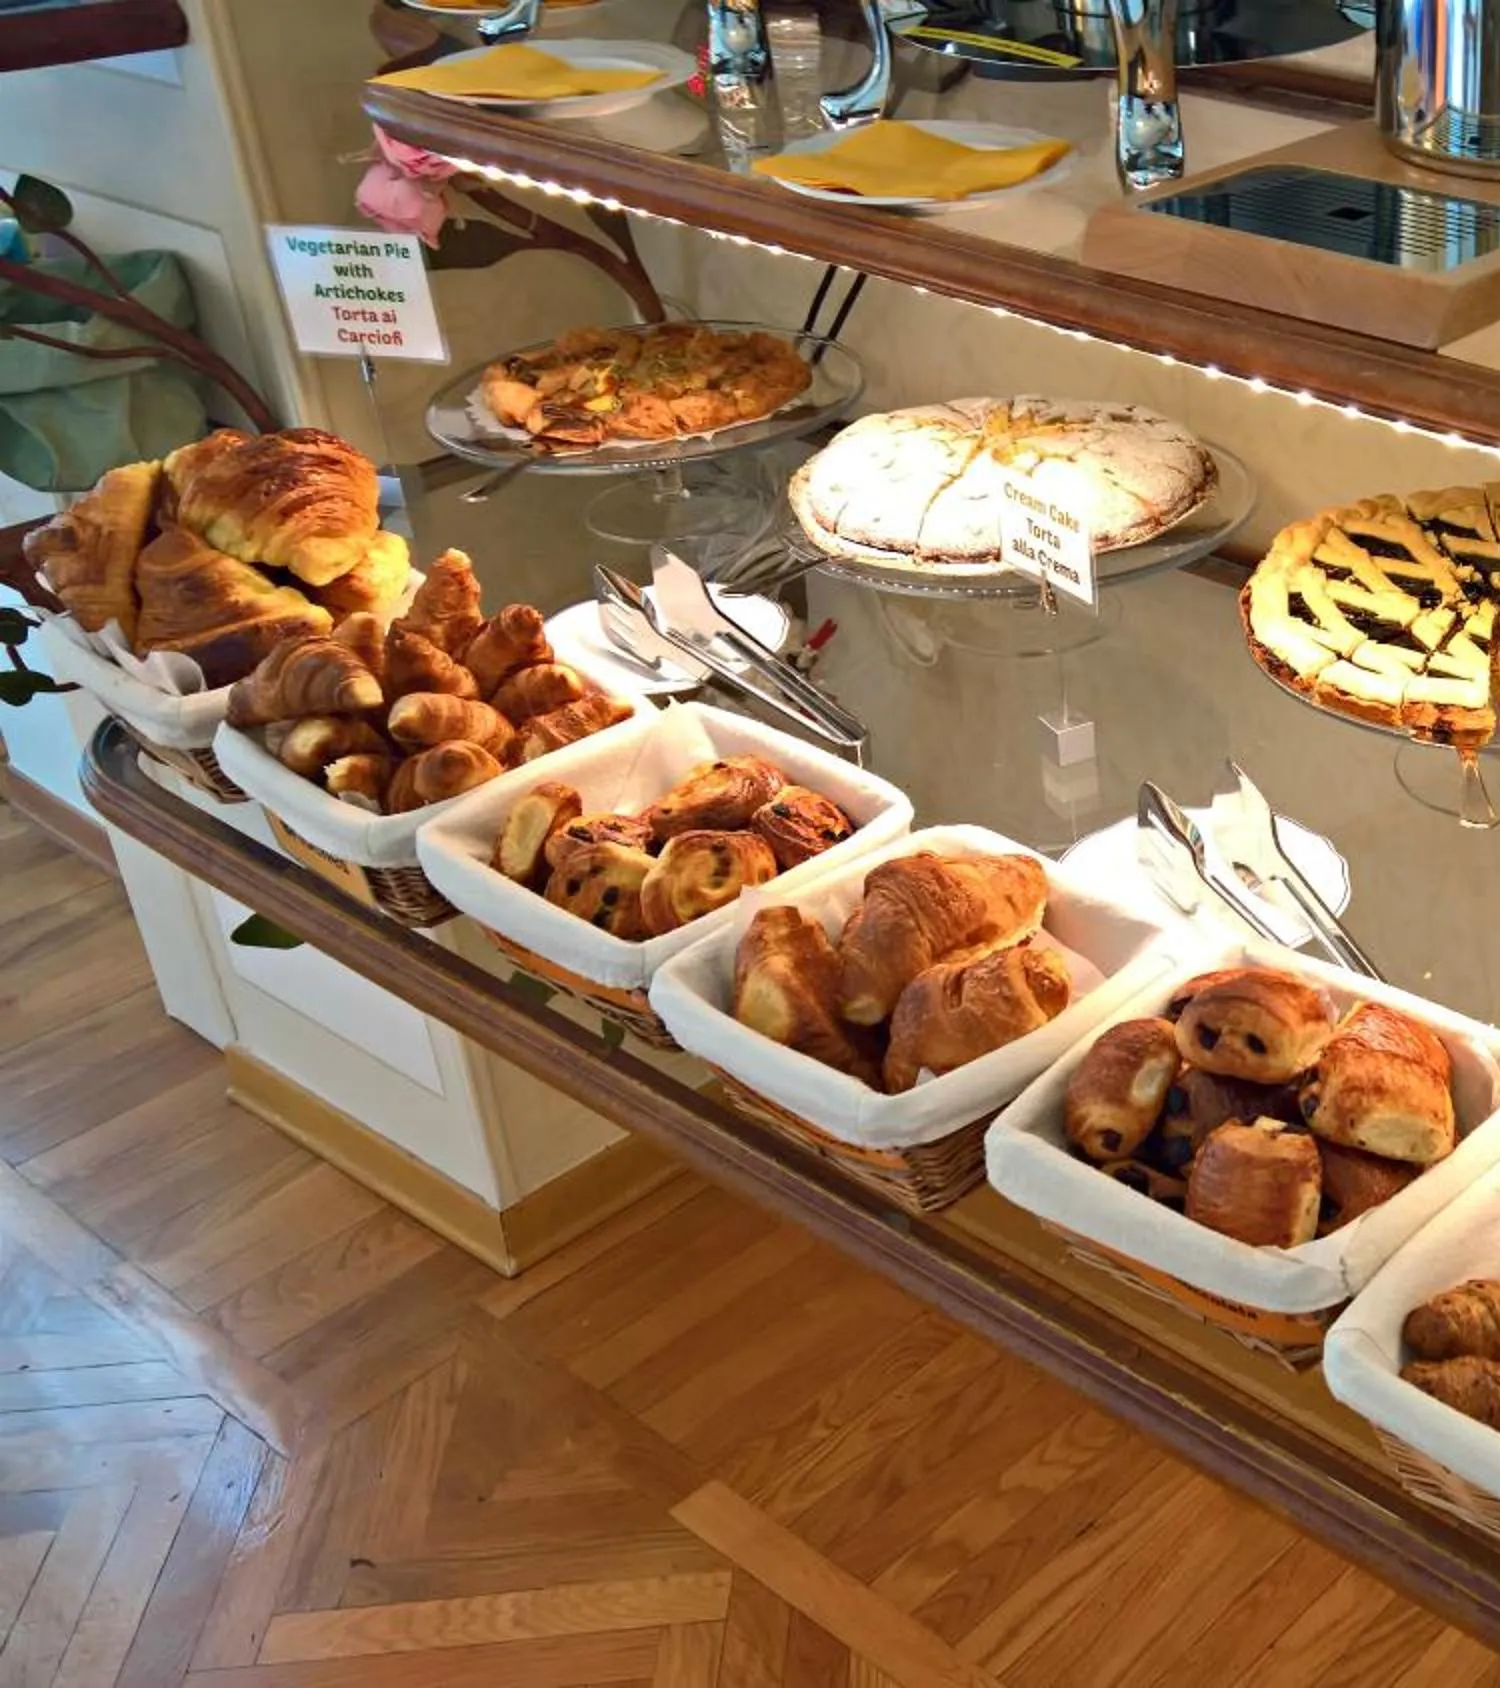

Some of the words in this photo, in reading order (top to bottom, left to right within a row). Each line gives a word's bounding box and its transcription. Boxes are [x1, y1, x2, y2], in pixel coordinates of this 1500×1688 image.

[285, 236, 381, 257] Vegetarian
[385, 243, 411, 259] Pie
[333, 262, 373, 279] with
[314, 283, 405, 303] Artichokes
[331, 305, 378, 322] Torta
[381, 308, 397, 324] ai
[337, 327, 403, 346] Carciofi
[1003, 481, 1047, 515] Cream
[1049, 504, 1080, 534] Cake
[1026, 517, 1061, 550] Torta
[1012, 538, 1035, 561] alla
[1037, 549, 1081, 586] Crema
